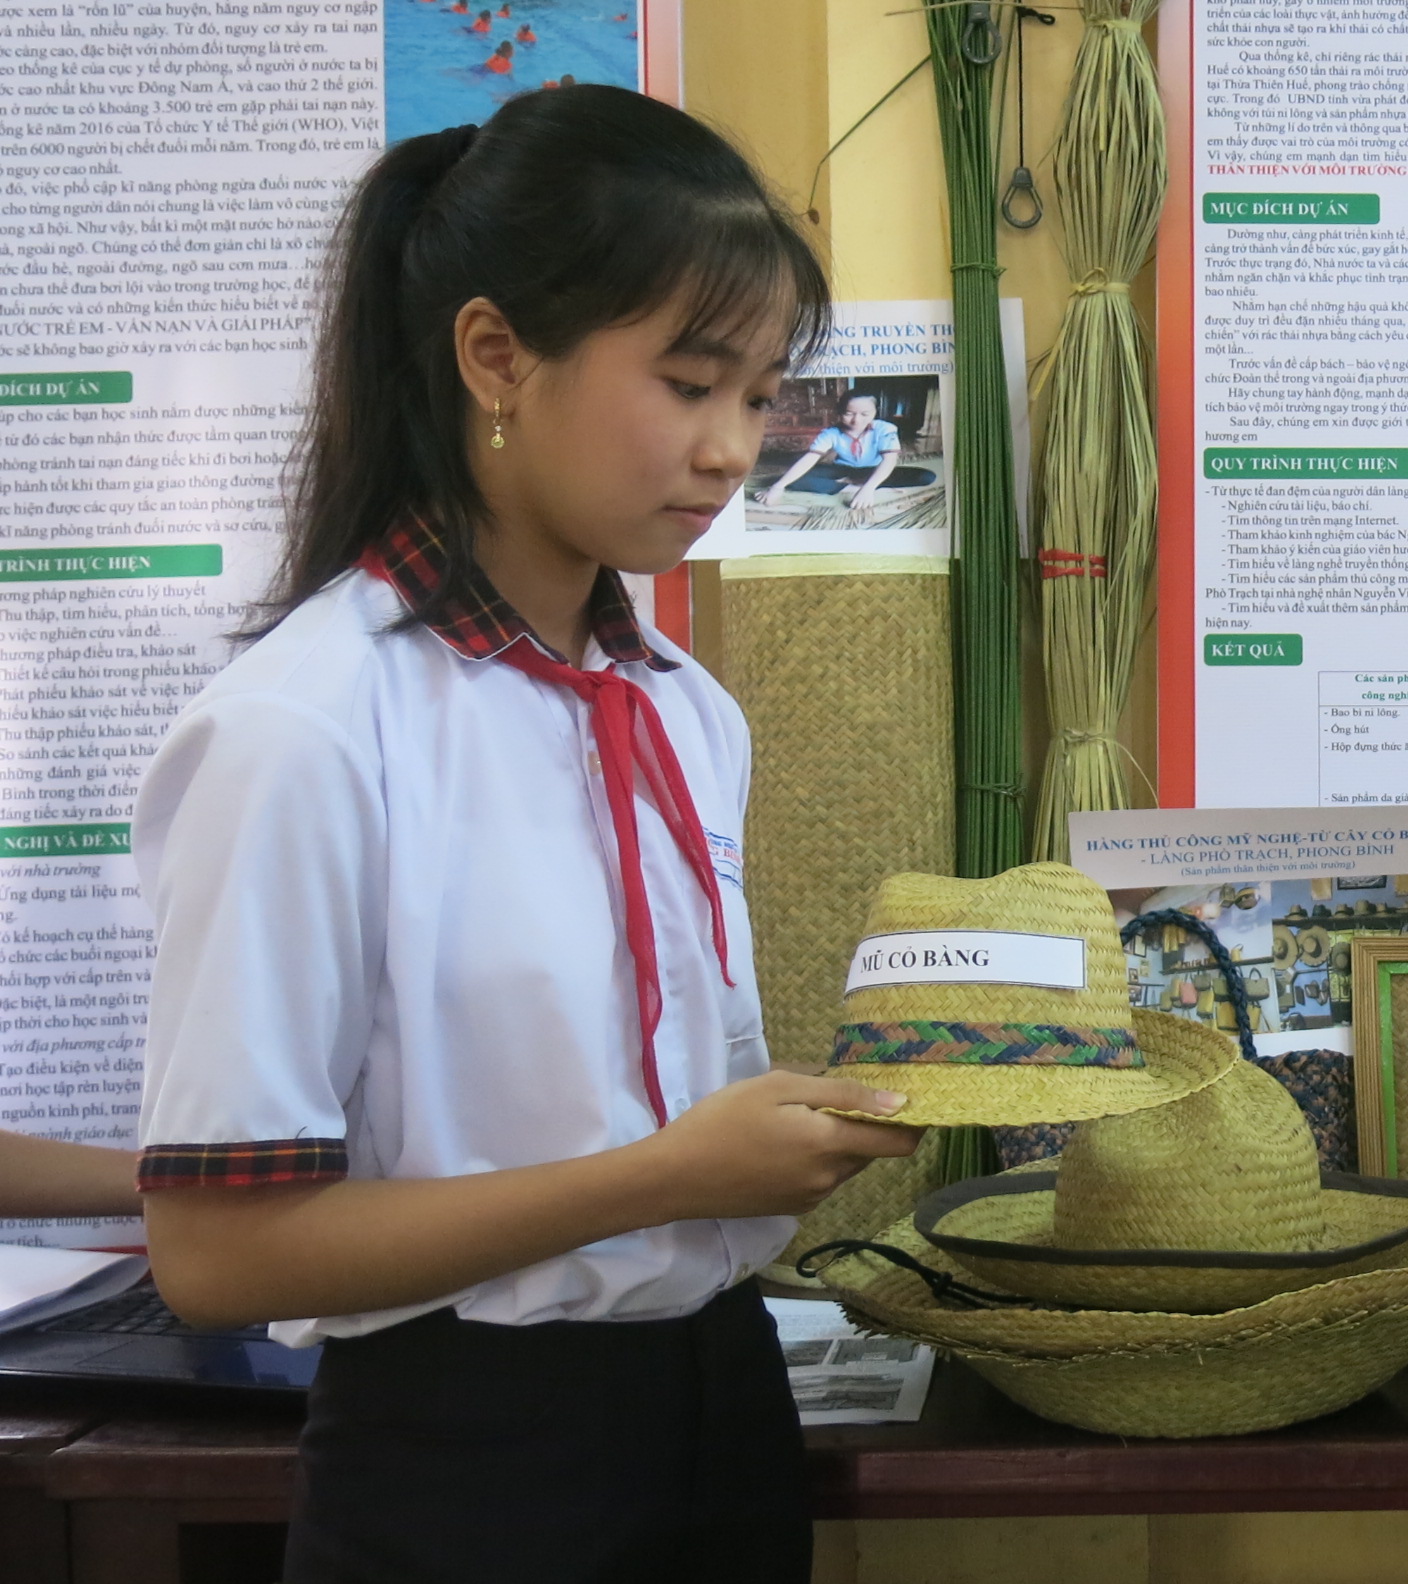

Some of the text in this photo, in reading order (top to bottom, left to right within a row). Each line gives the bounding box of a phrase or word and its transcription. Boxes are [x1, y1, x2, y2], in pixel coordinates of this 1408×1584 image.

[1210, 200, 1347, 218] MỤC ĐÍCH DỰ ÁN
[0, 378, 100, 398] ĐÍCH DỰ ÁN
[1211, 454, 1397, 473] QUY TRÌNH THỰC HIỆN
[0, 554, 150, 573] TRÌNH THỰC HIỆN
[1212, 641, 1284, 659] KẾT QUẢ
[1086, 837, 1133, 851] HÀNG
[1137, 834, 1170, 852] THỦ
[1175, 833, 1225, 850] CÔNG
[1227, 832, 1251, 844] MỸ
[1334, 829, 1369, 844] CÂY
[1371, 828, 1394, 845] CỎ
[1150, 850, 1194, 864] LÀNG
[1199, 847, 1230, 862] PHÒ
[1234, 848, 1292, 861] TRẠCH,
[1294, 843, 1351, 858] PHONG
[1355, 842, 1393, 856] BÌNH
[860, 945, 990, 973] MŨ CỎ BÀNG
